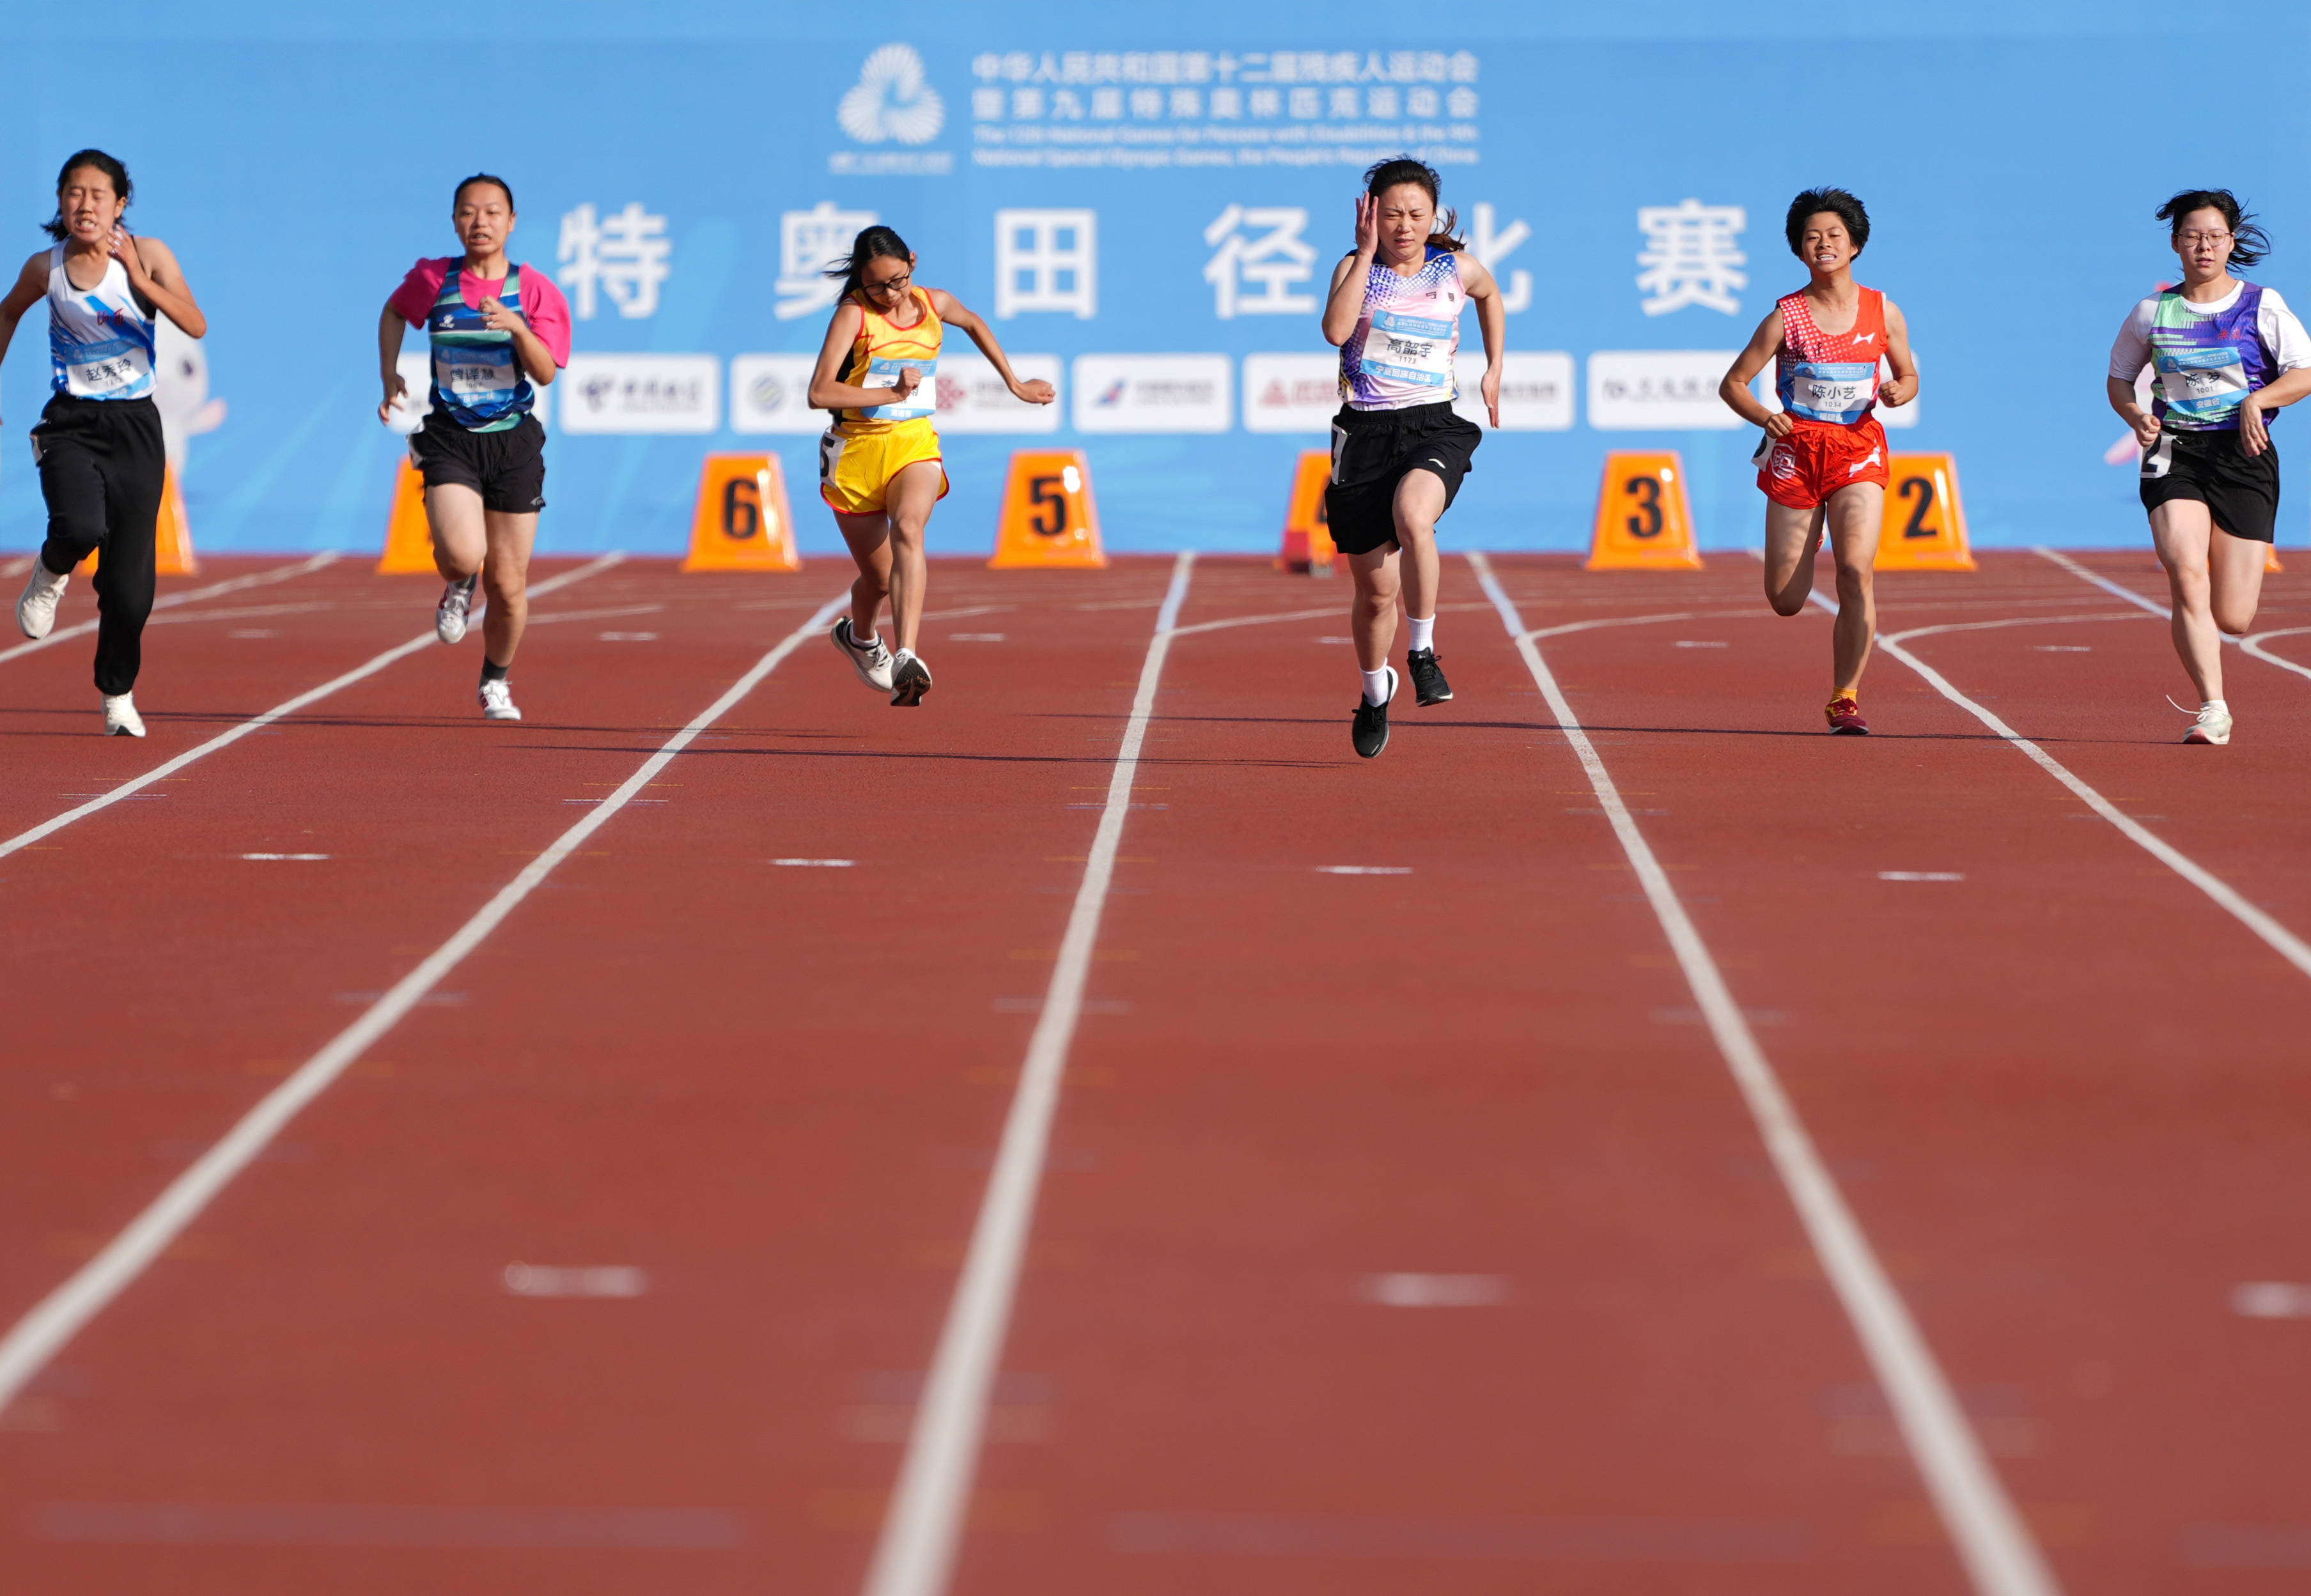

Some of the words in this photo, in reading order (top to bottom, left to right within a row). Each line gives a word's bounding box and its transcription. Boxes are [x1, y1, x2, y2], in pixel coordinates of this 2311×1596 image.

[1399, 355, 1417, 364] 1173
[1812, 384, 1857, 399] 陈小艺
[2197, 386, 2214, 395] 1001
[722, 477, 758, 539] 6
[1030, 476, 1066, 536] 5
[1625, 476, 1663, 538] 3
[1900, 477, 1938, 539] 2
